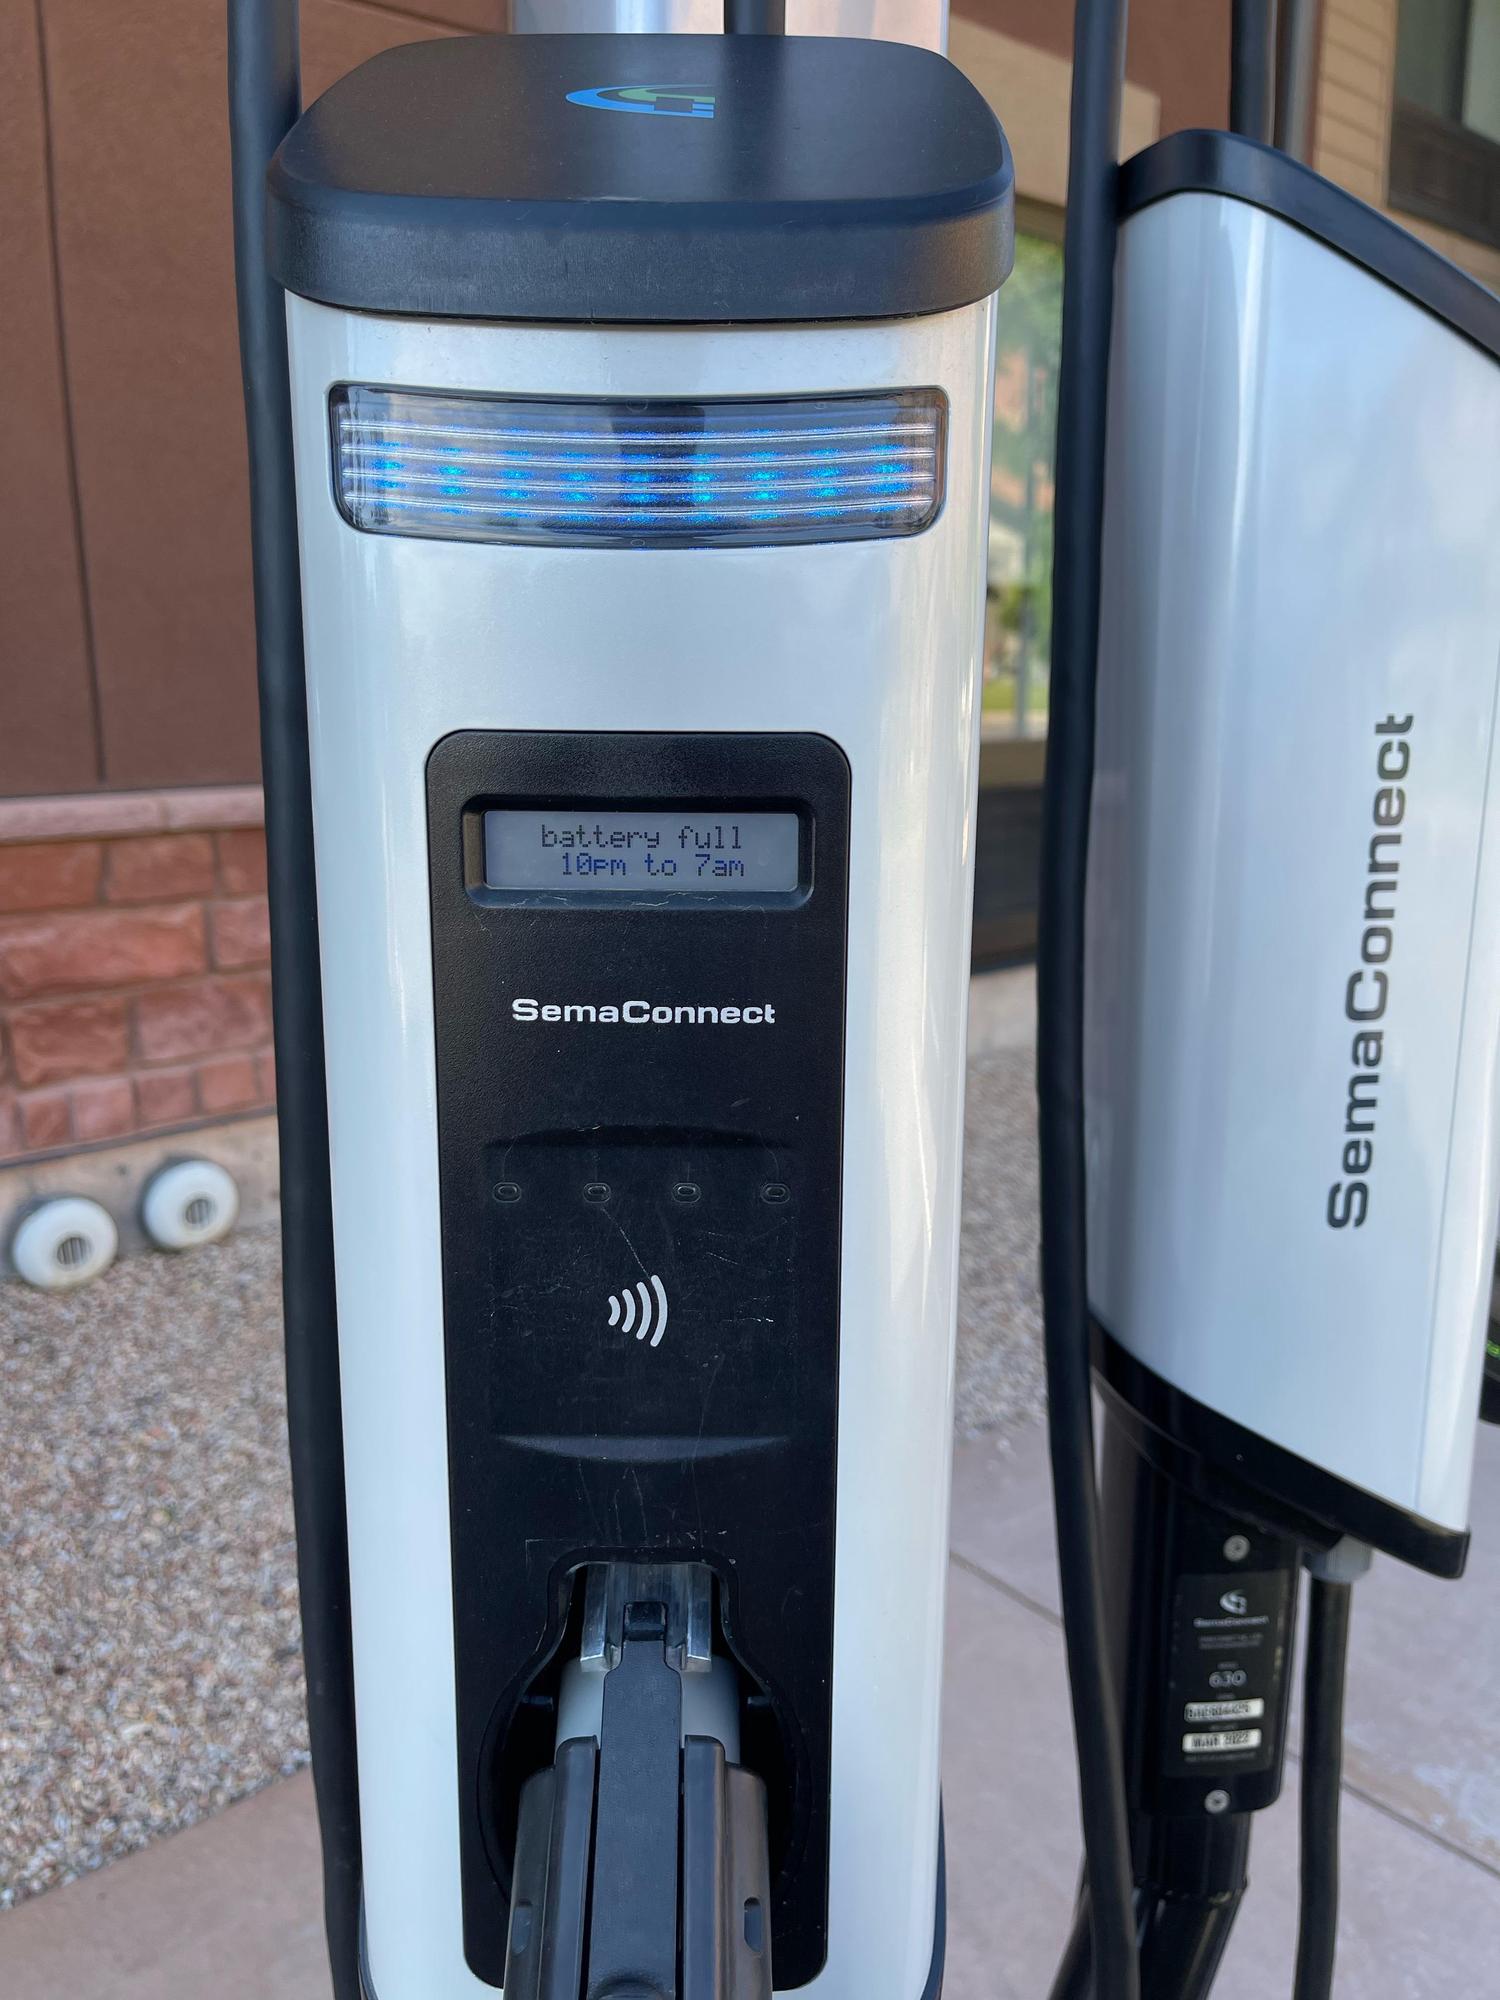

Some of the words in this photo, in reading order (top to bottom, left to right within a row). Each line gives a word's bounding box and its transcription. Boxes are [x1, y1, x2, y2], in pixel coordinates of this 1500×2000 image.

[541, 824, 660, 849] battery
[678, 825, 743, 850] full
[562, 852, 627, 876] 10pm
[644, 852, 677, 877] to
[695, 853, 745, 877] 7am
[1326, 712, 1415, 1230] SemaConnect
[511, 998, 776, 1025] SemaConnect
